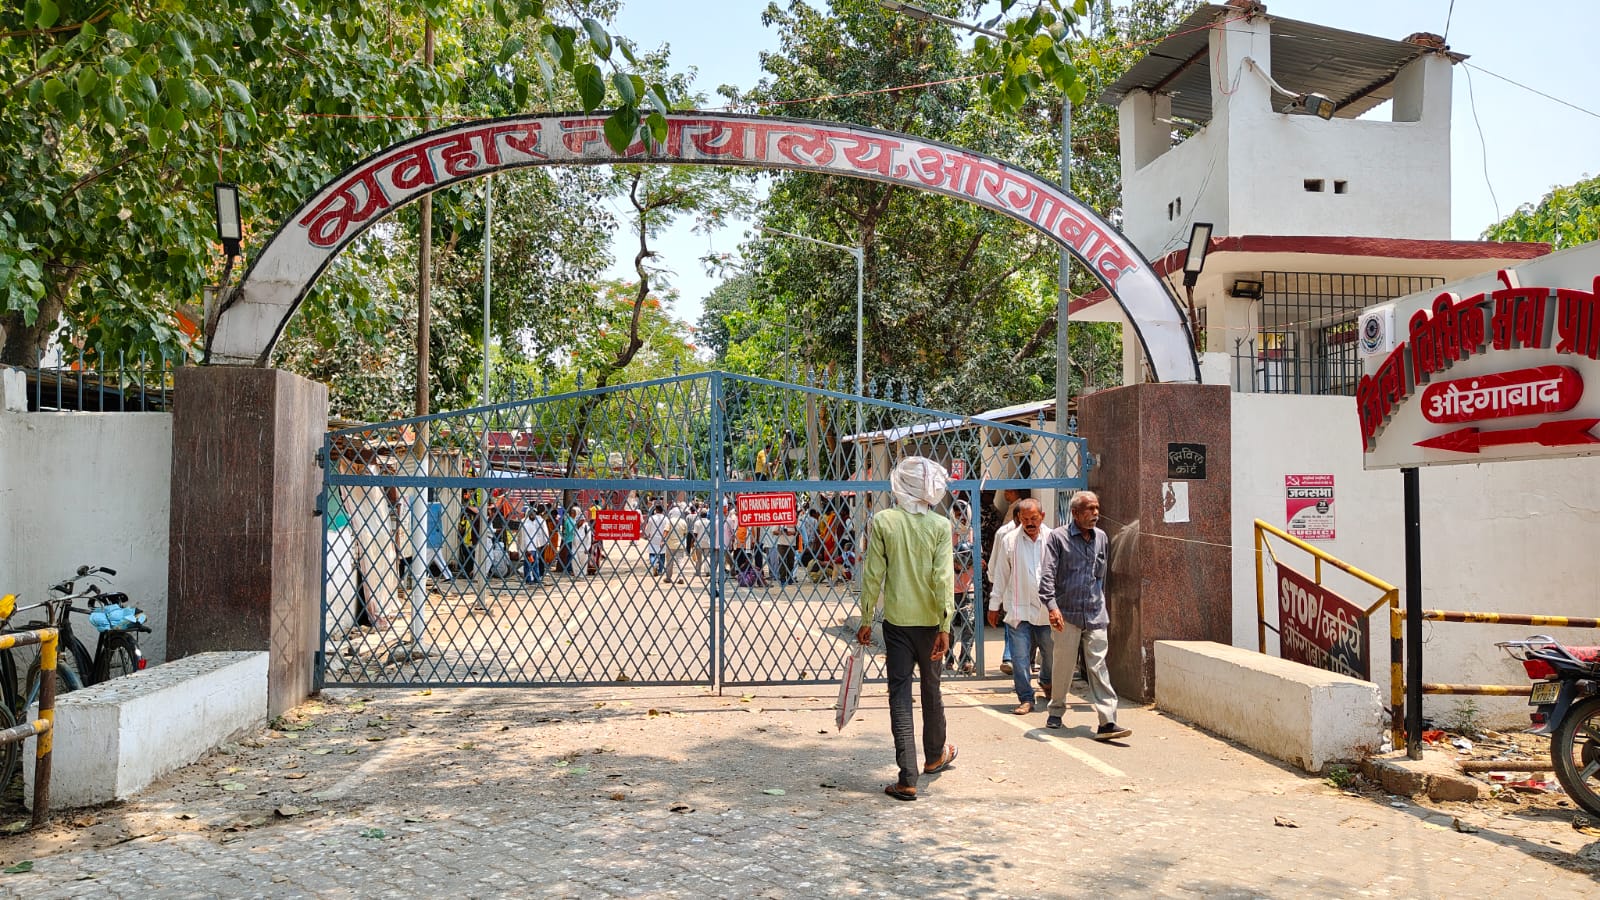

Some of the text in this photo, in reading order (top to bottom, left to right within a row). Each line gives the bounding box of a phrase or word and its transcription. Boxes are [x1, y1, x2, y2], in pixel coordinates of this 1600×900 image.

[298, 121, 548, 247] व्यवहार
[1408, 292, 1486, 386] विधिक
[1492, 269, 1551, 350] सेवा
[1428, 377, 1563, 418] औरंगाबाद
[740, 497, 791, 511] NO PARKING INFRONT
[742, 511, 792, 522] OF THIS GATE
